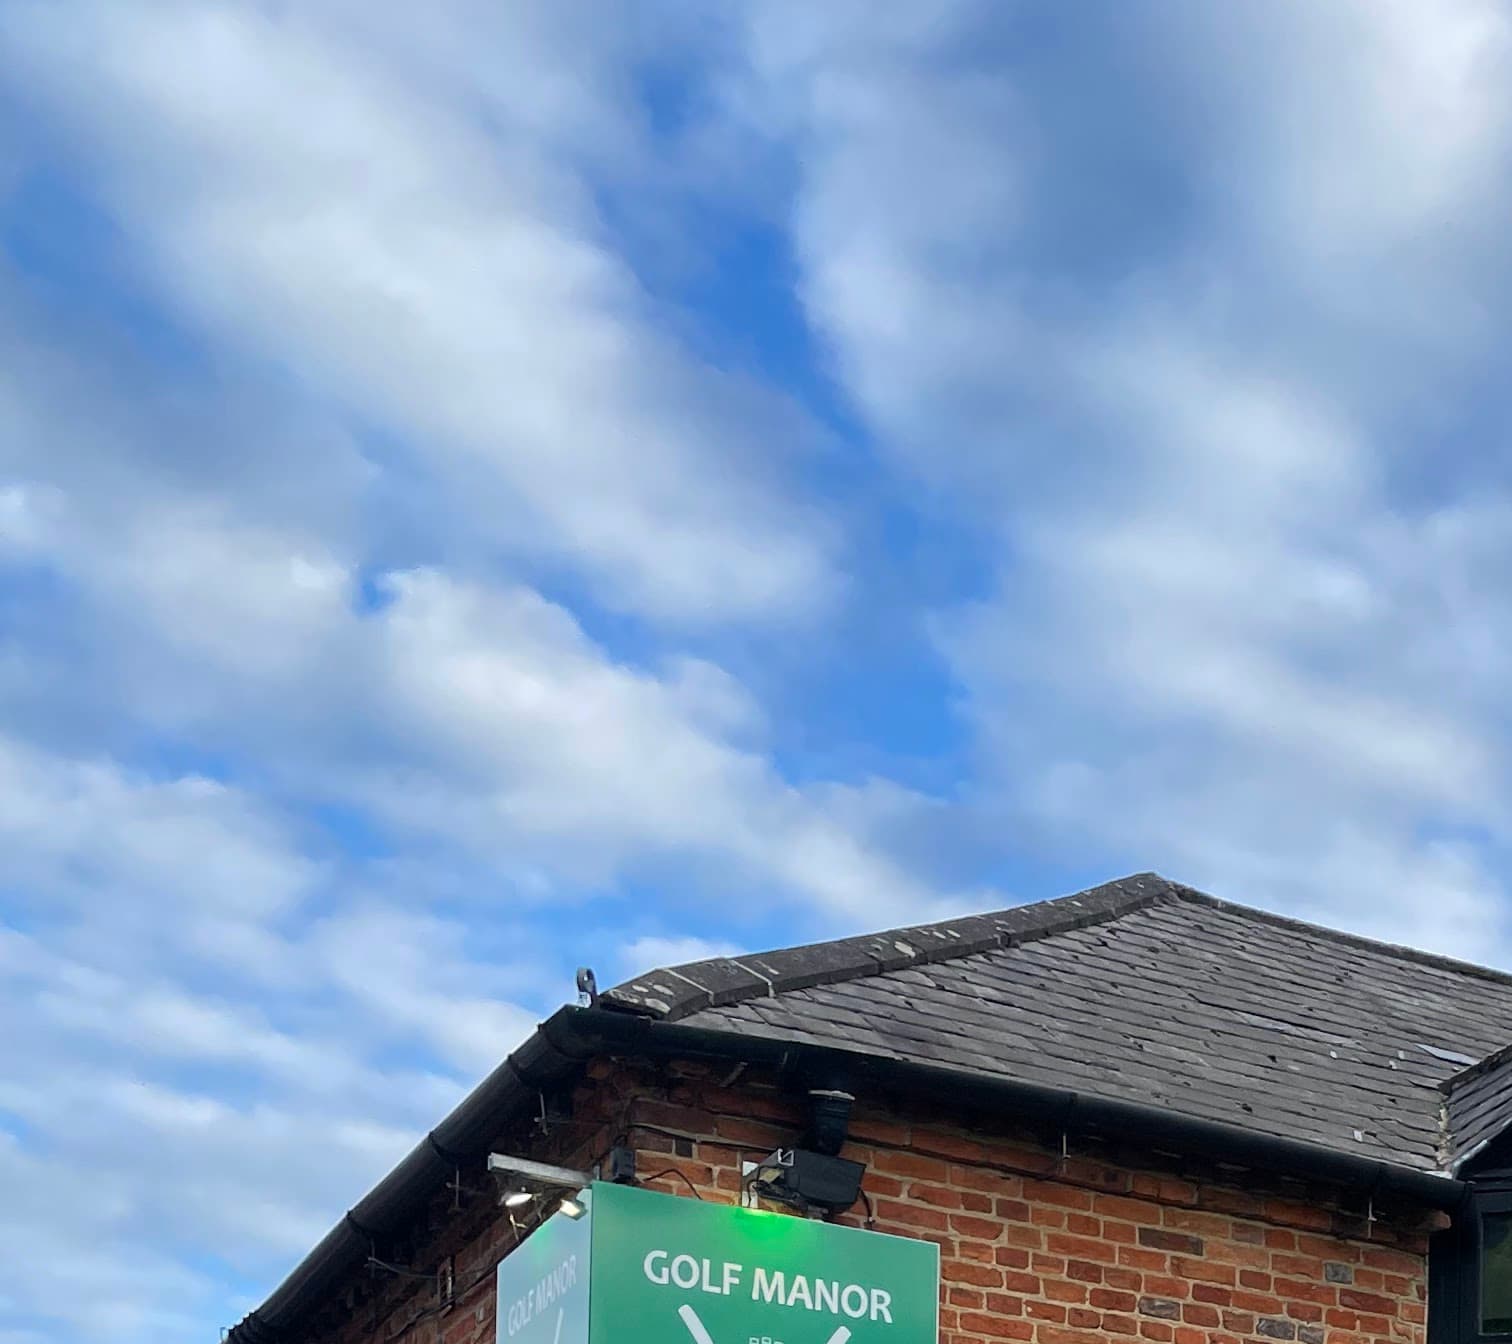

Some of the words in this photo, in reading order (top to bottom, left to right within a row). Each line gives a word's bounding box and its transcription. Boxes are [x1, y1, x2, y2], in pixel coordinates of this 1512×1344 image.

[508, 1289, 534, 1336] GOLF
[536, 1254, 576, 1315] MANOR
[643, 1249, 742, 1295] GOLF
[752, 1267, 893, 1324] MANOR
